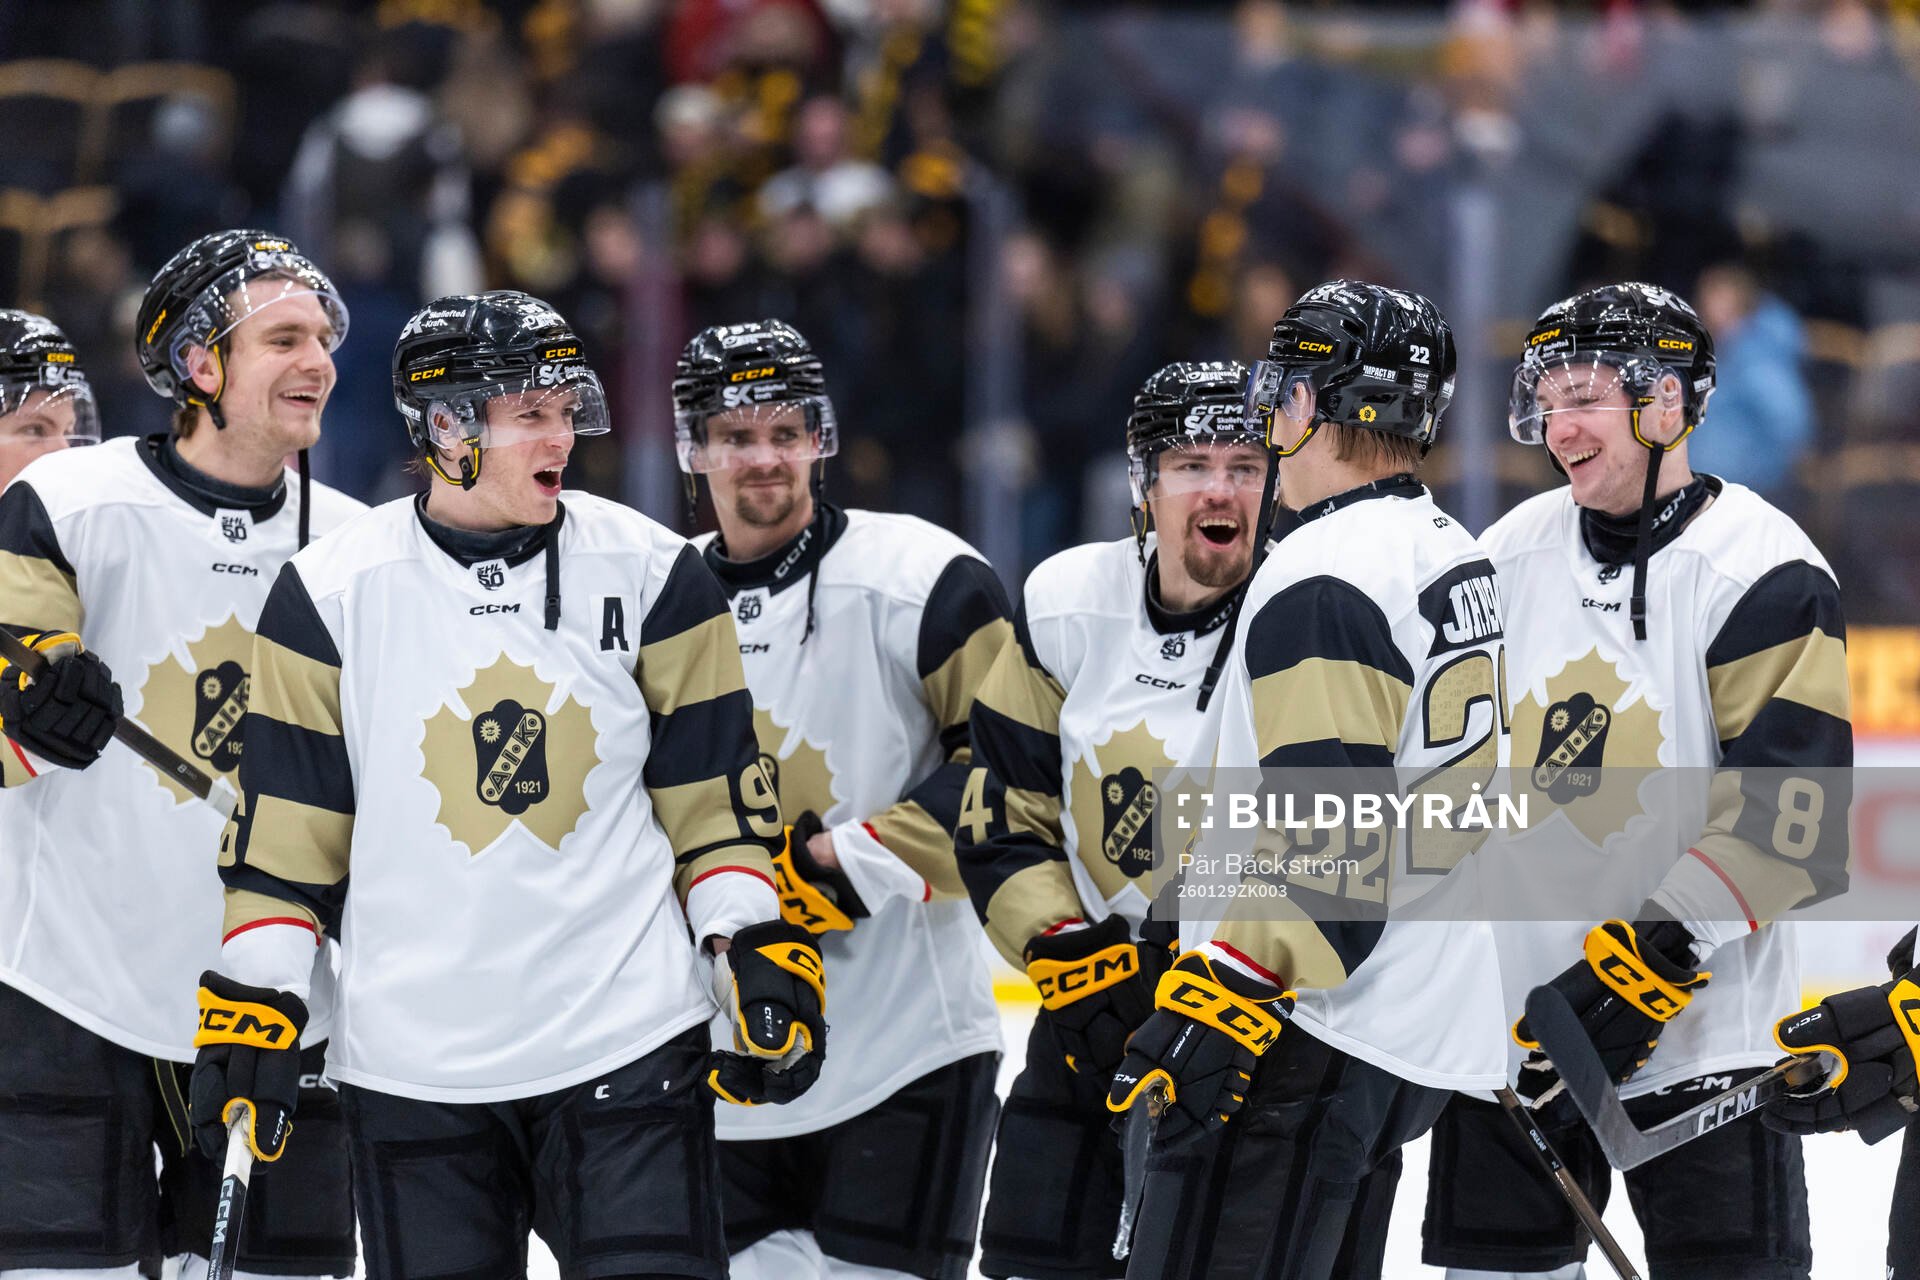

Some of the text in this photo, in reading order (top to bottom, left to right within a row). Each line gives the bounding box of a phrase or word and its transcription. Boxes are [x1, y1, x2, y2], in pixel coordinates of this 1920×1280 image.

[1531, 328, 1561, 346] CCM
[1658, 339, 1694, 351] CCM
[545, 347, 577, 359] CCM
[1298, 341, 1333, 353] CCM
[1409, 344, 1430, 365] 22
[410, 367, 445, 382] CCM
[731, 367, 776, 383] CCM
[1191, 404, 1244, 416] CCM
[1184, 414, 1216, 435] SK
[774, 528, 812, 578] CCM
[212, 562, 259, 576] CCM
[469, 603, 521, 615] CCM
[600, 597, 629, 651] A
[739, 644, 770, 654] CM
[1135, 673, 1187, 690] CCM
[515, 780, 541, 794] 1921
[1566, 773, 1592, 787] 1921
[1771, 776, 1825, 860] 8
[1132, 848, 1156, 861] 1921
[1787, 1013, 1822, 1034] CCM
[1697, 1085, 1758, 1136] CCM
[271, 1109, 285, 1146] CCM
[213, 1179, 234, 1244] CCM
